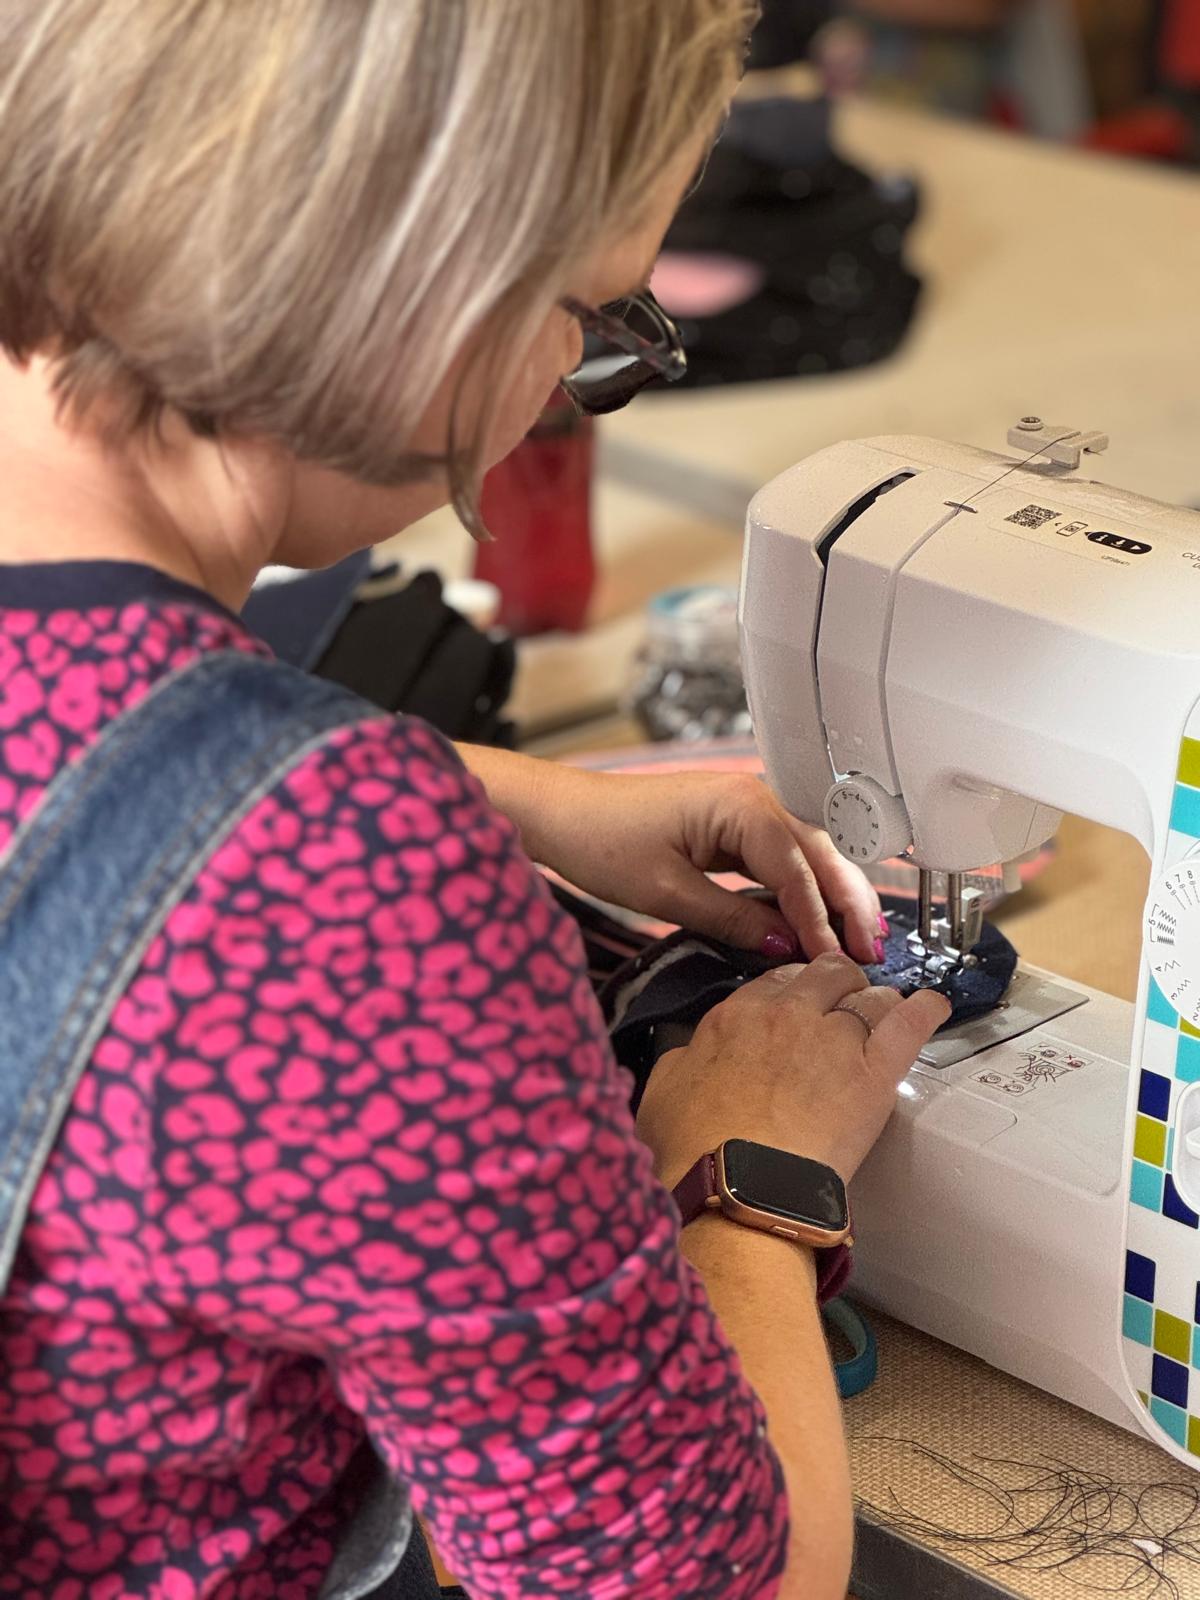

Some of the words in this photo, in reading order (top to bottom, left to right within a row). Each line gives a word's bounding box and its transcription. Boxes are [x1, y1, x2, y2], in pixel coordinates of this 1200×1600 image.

[1182, 552, 1200, 561] CU
[1174, 873, 1181, 883] 7
[1187, 870, 1193, 879] 8
[1165, 881, 1172, 890] 6
[1170, 992, 1178, 1001] 3
